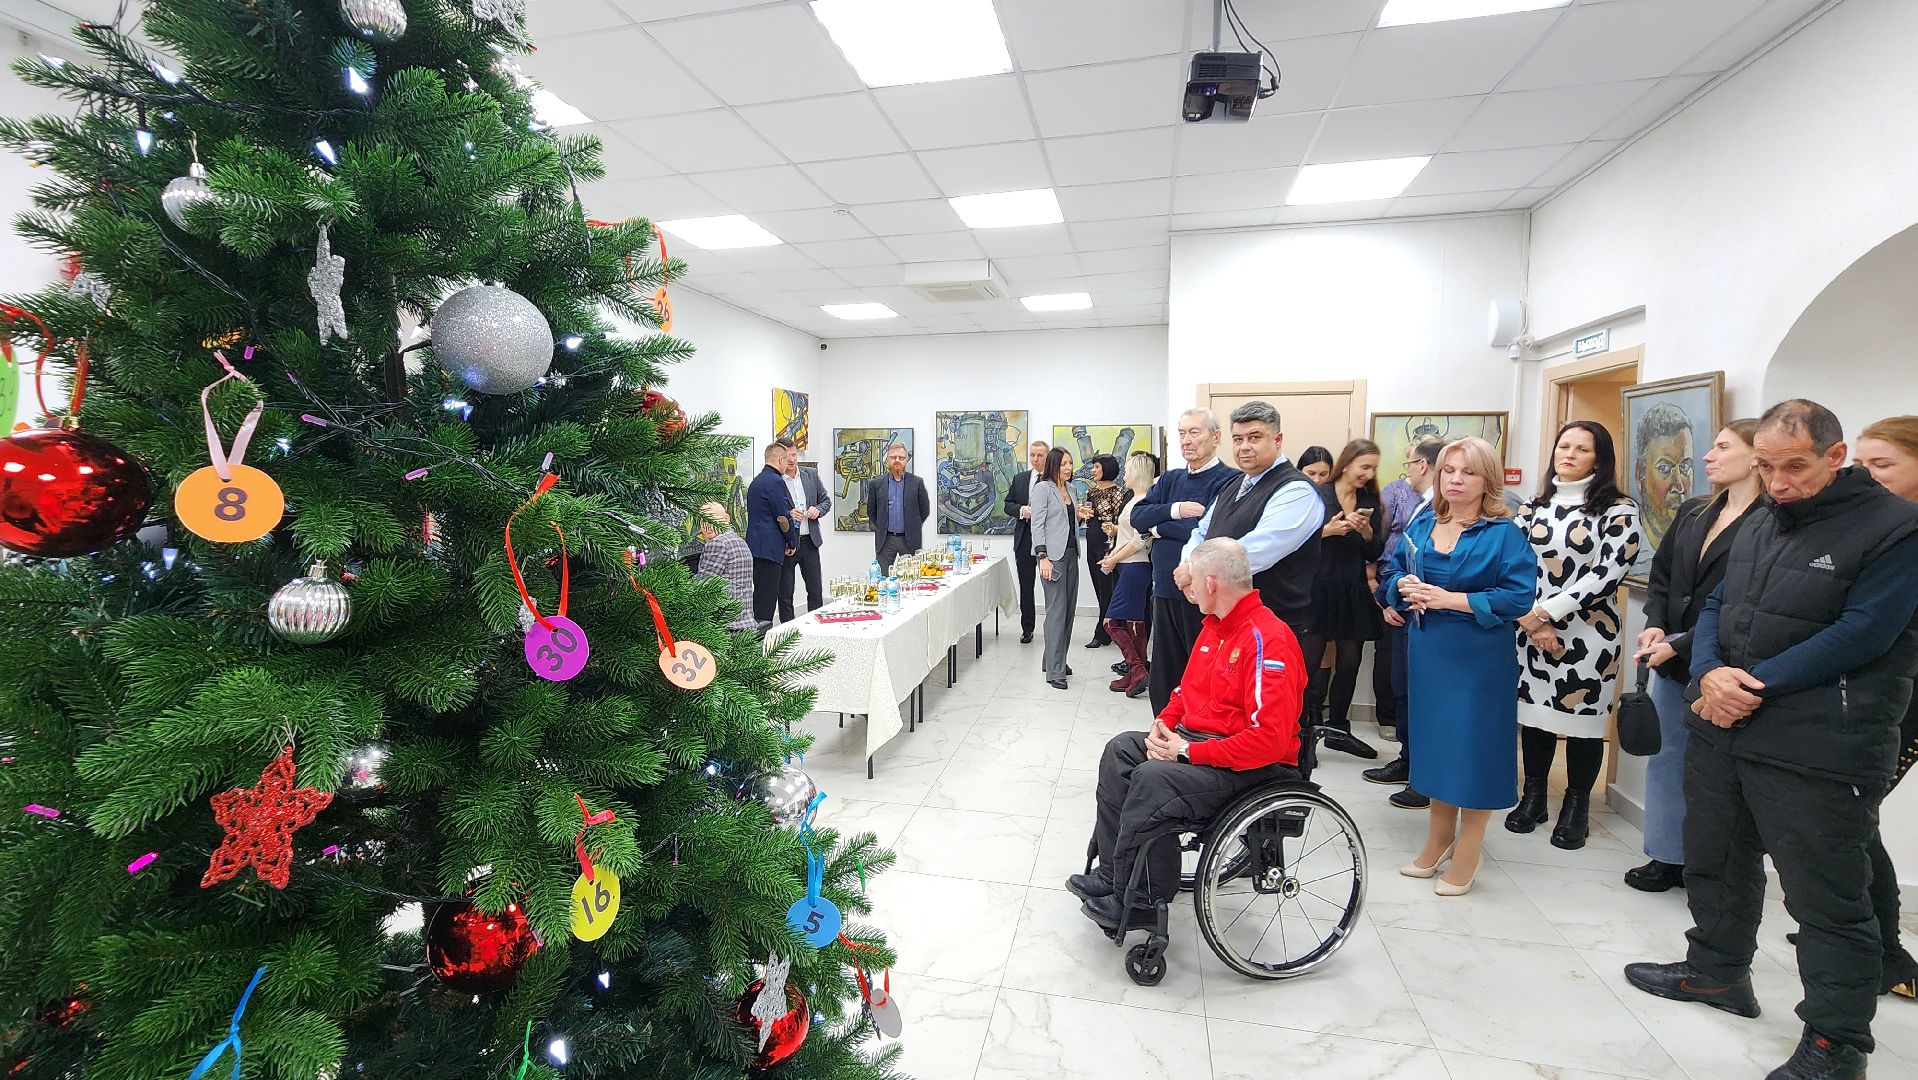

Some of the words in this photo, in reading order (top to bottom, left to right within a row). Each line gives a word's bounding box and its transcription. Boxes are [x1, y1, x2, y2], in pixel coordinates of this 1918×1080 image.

[213, 486, 248, 522] 8
[536, 627, 578, 672] 30
[671, 648, 708, 683] 32
[802, 910, 825, 934] 5
